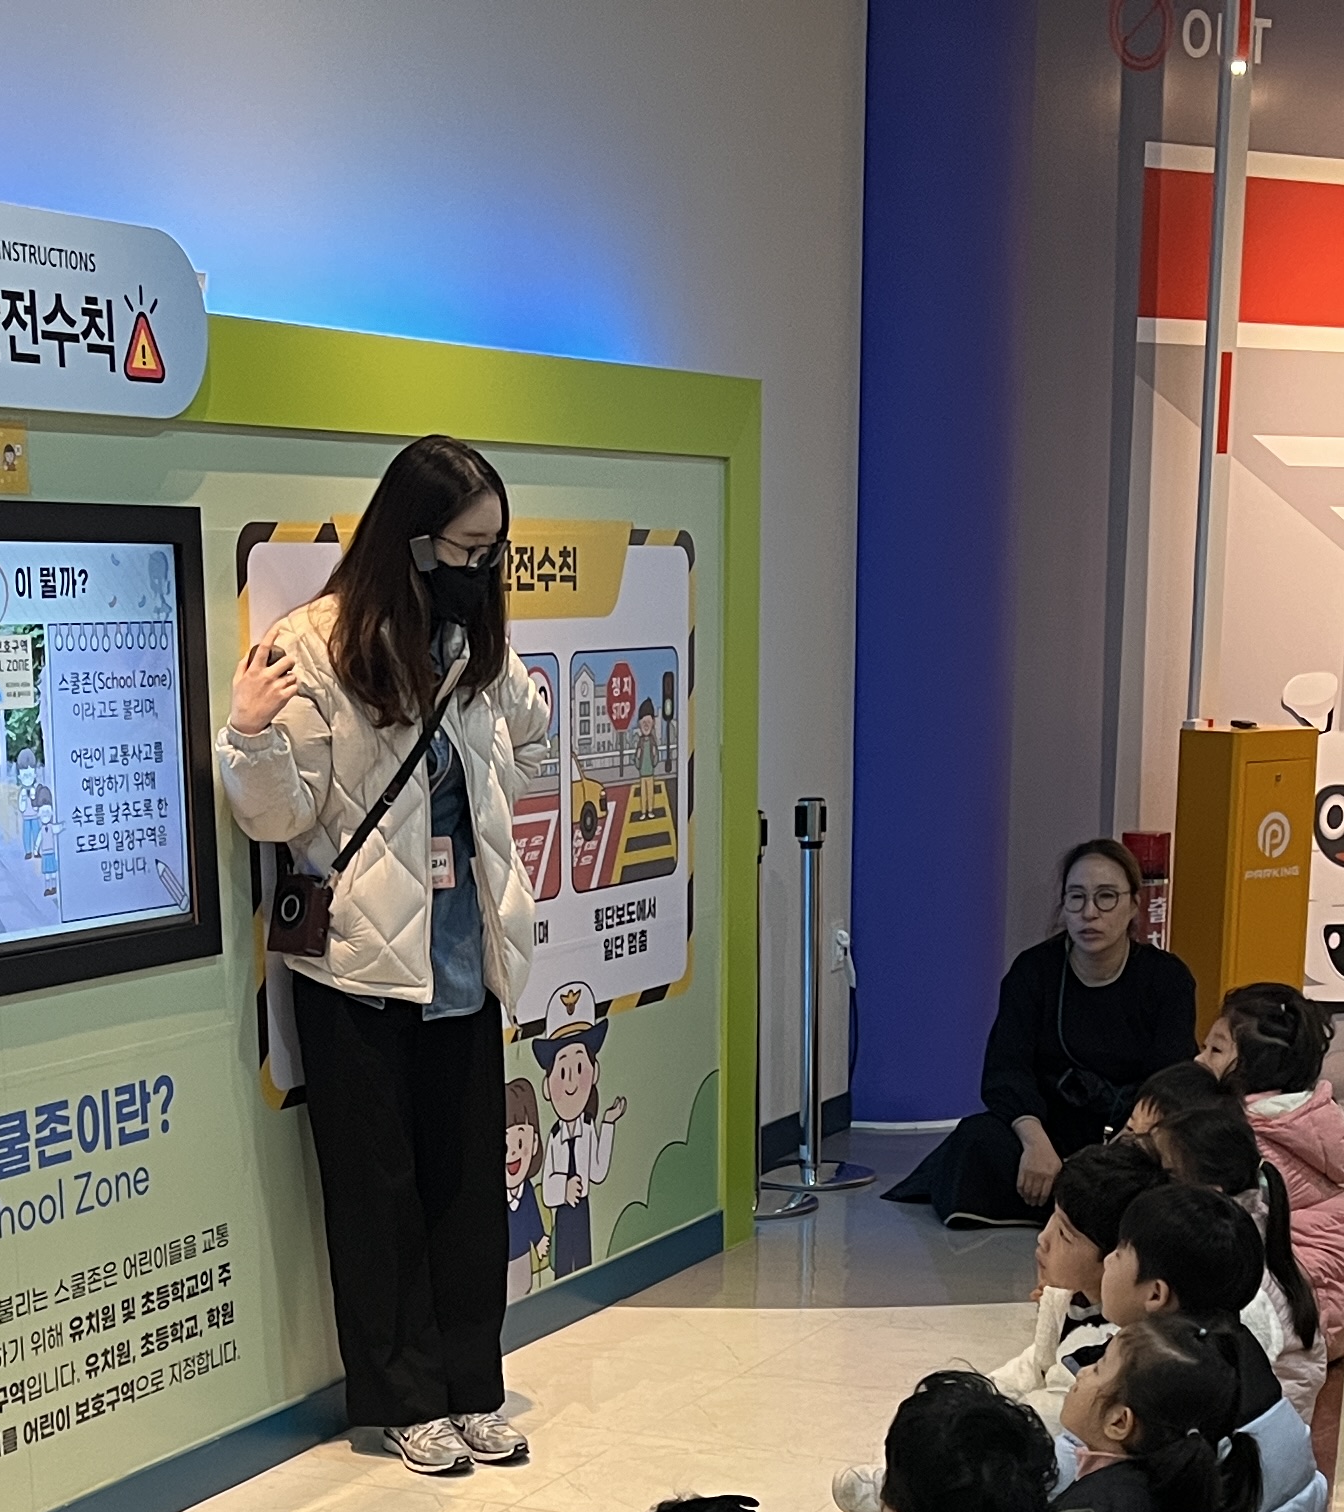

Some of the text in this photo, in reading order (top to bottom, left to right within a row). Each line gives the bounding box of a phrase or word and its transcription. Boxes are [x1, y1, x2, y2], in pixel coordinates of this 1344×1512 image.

[1182, 8, 1272, 65] OT
[15, 567, 32, 600] 이
[39, 566, 89, 600] 뭘까?
[6, 658, 31, 672] ZONE
[58, 667, 172, 695] 스쿨존(School Zone)
[72, 700, 119, 721] 이라고도
[611, 701, 631, 720] STOP
[70, 741, 164, 769] 어린이 교통사고를
[81, 770, 156, 797] 예방하기 위해
[71, 797, 169, 828] 속도를 낮추도록 한
[75, 824, 168, 854] 도로의 일정구역을
[1244, 864, 1300, 882] PARKING
[594, 895, 657, 932] 횡단보도에서
[603, 929, 648, 962] 일단 멈춤
[73, 1166, 150, 1216] Zone
[54, 1261, 118, 1305] 스쿨존은
[123, 1234, 197, 1280] 어린이들을
[201, 1222, 230, 1254] 교통
[30, 1321, 64, 1356] 위해
[69, 1303, 116, 1343] 유치원
[121, 1296, 136, 1324] 및
[140, 1267, 214, 1316] 초등학교의
[217, 1262, 232, 1287] 주
[85, 1339, 136, 1380] 유치원,
[140, 1314, 204, 1358] 초등학교,
[206, 1300, 235, 1331] 학원
[23, 1405, 71, 1445] 어린이
[75, 1368, 165, 1425] 보호구역으로
[168, 1338, 242, 1387] 지정합니다.
